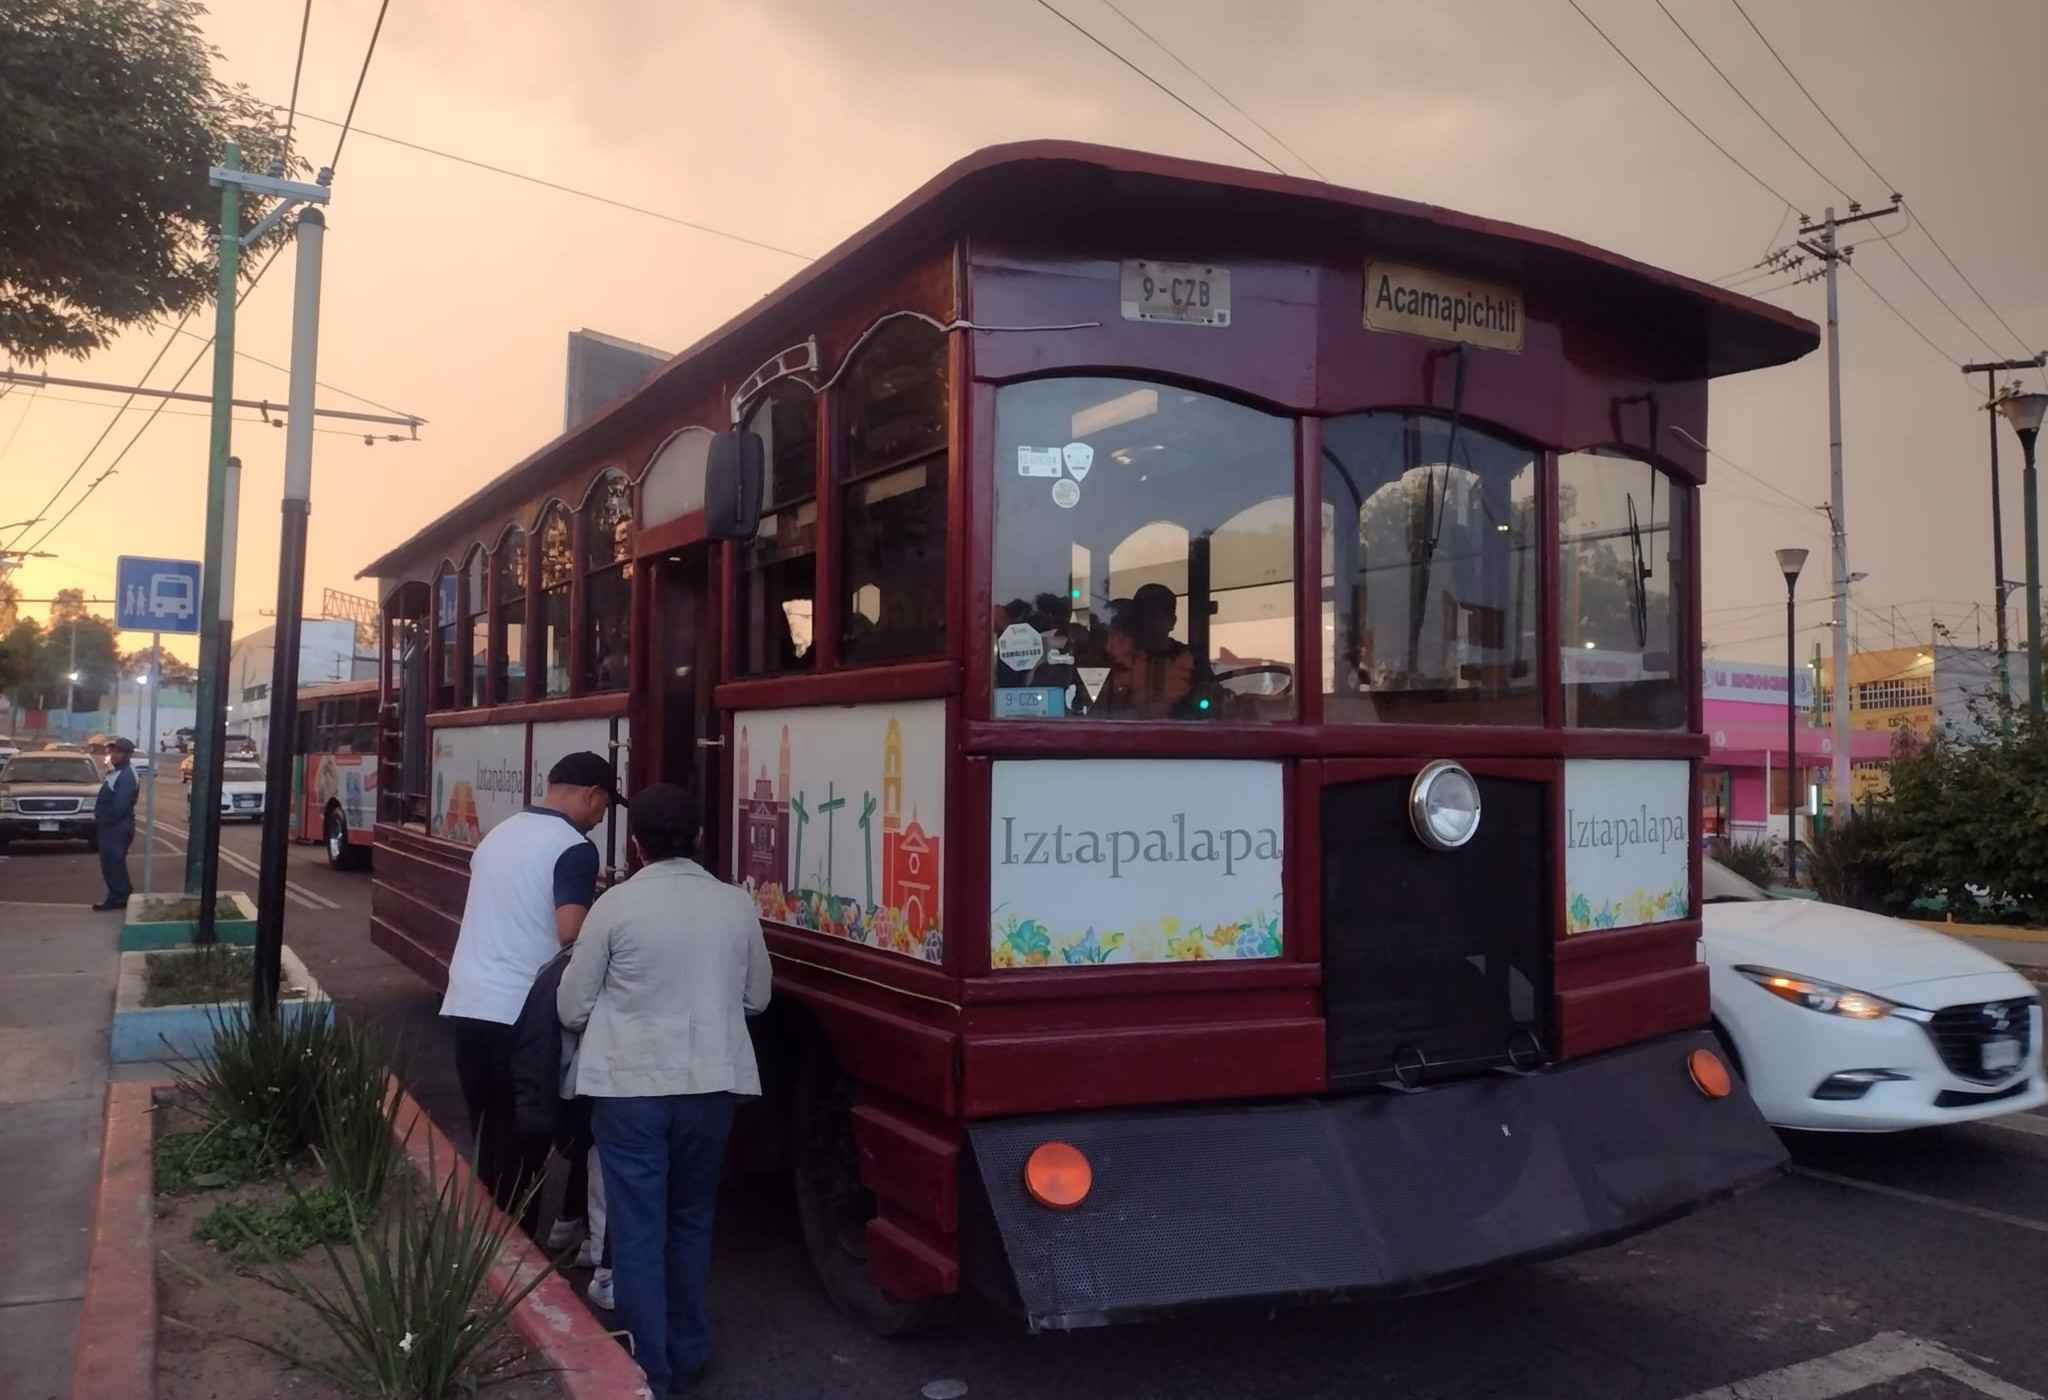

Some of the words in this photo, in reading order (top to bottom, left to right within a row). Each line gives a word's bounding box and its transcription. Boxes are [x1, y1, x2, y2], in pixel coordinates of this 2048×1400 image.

[1143, 276, 1210, 307] 9-CZB
[1376, 274, 1516, 333] Acamapichtli
[1000, 812, 1283, 878] Iztapalapa
[1567, 803, 1686, 858] Iztapalapa
